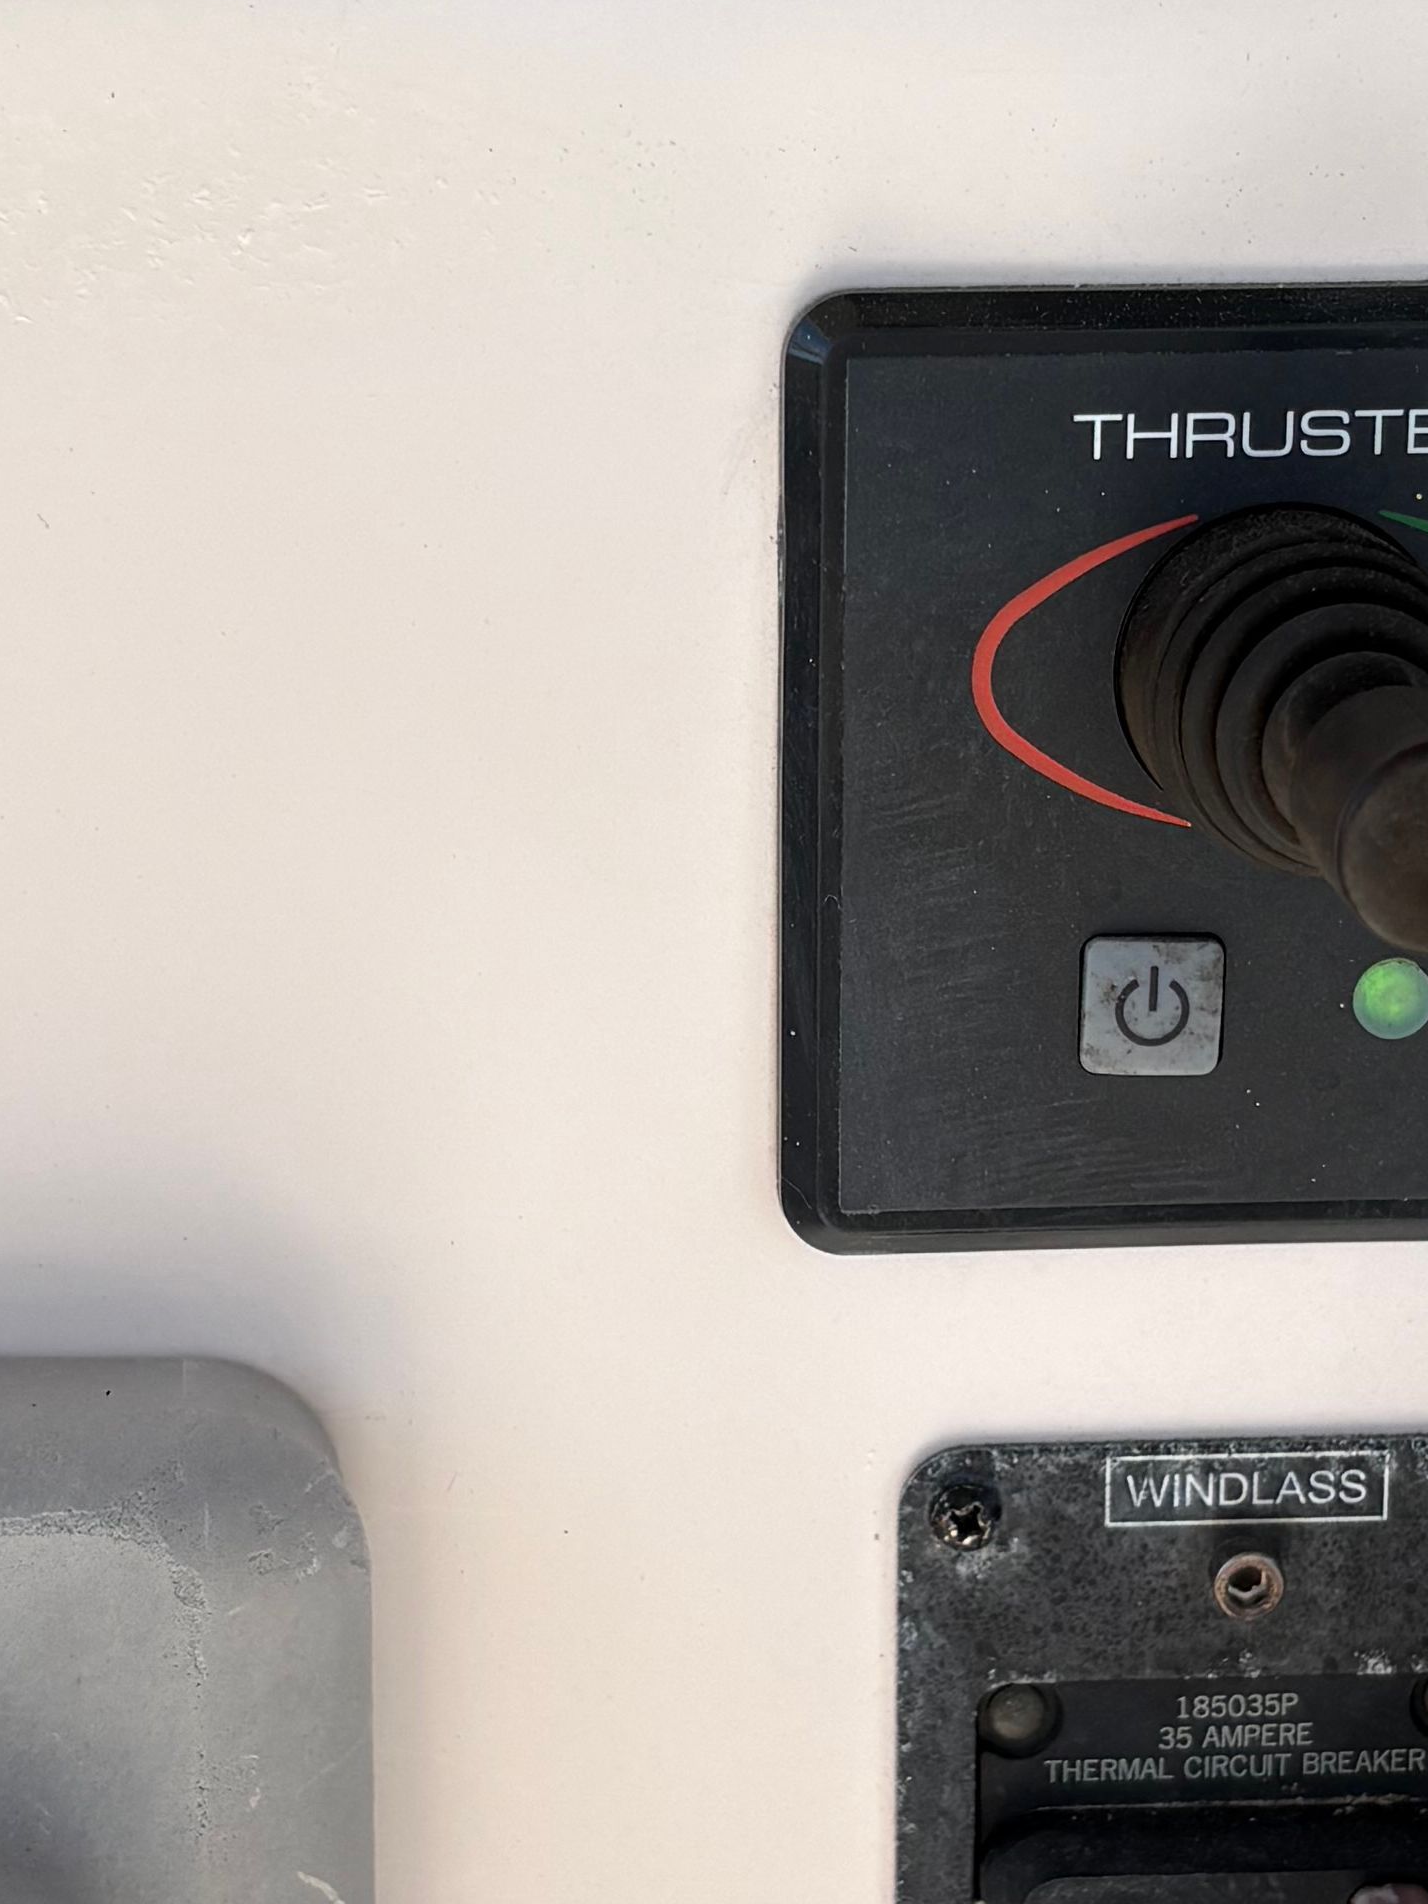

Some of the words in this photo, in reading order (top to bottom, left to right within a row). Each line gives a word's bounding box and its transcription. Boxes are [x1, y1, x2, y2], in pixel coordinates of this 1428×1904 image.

[1126, 1468, 1368, 1508] WINDLASS
[1176, 1693, 1300, 1719] 185035P
[1158, 1726, 1193, 1751] 35
[1203, 1722, 1314, 1749] AMPERE
[1044, 1757, 1174, 1784] THERMAL
[1183, 1752, 1292, 1780] CIRCUIT
[1302, 1748, 1426, 1776] BREAKER
